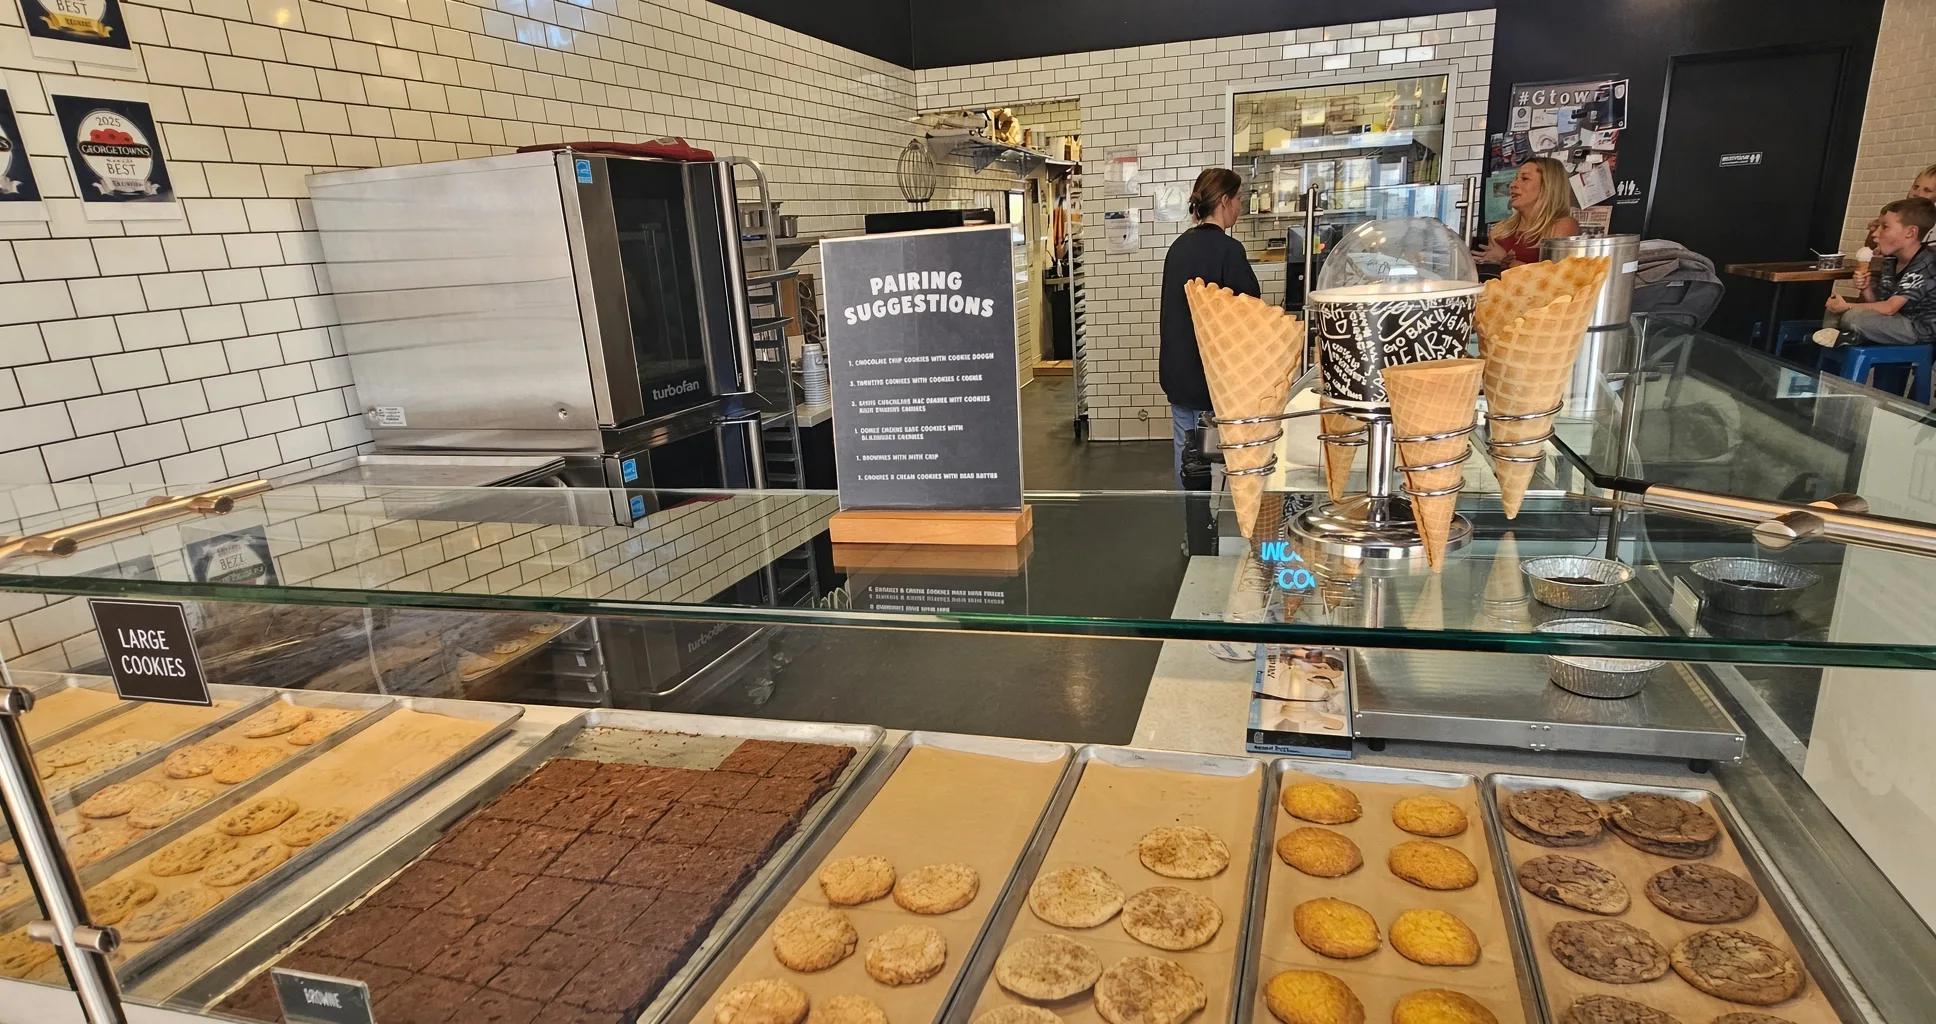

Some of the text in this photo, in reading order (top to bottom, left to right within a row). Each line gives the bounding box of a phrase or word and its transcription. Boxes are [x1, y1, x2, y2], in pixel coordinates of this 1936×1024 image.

[56, 0, 88, 16] BEST
[95, 116, 121, 127] 2025
[81, 144, 150, 156] GEORGETOWNS
[106, 163, 136, 176] BEST
[869, 270, 963, 296] PAIRING
[844, 293, 995, 326] SUGGESTIONS
[651, 379, 701, 401] turbofan
[117, 628, 170, 651] LARGE
[121, 655, 187, 678] COOKIES
